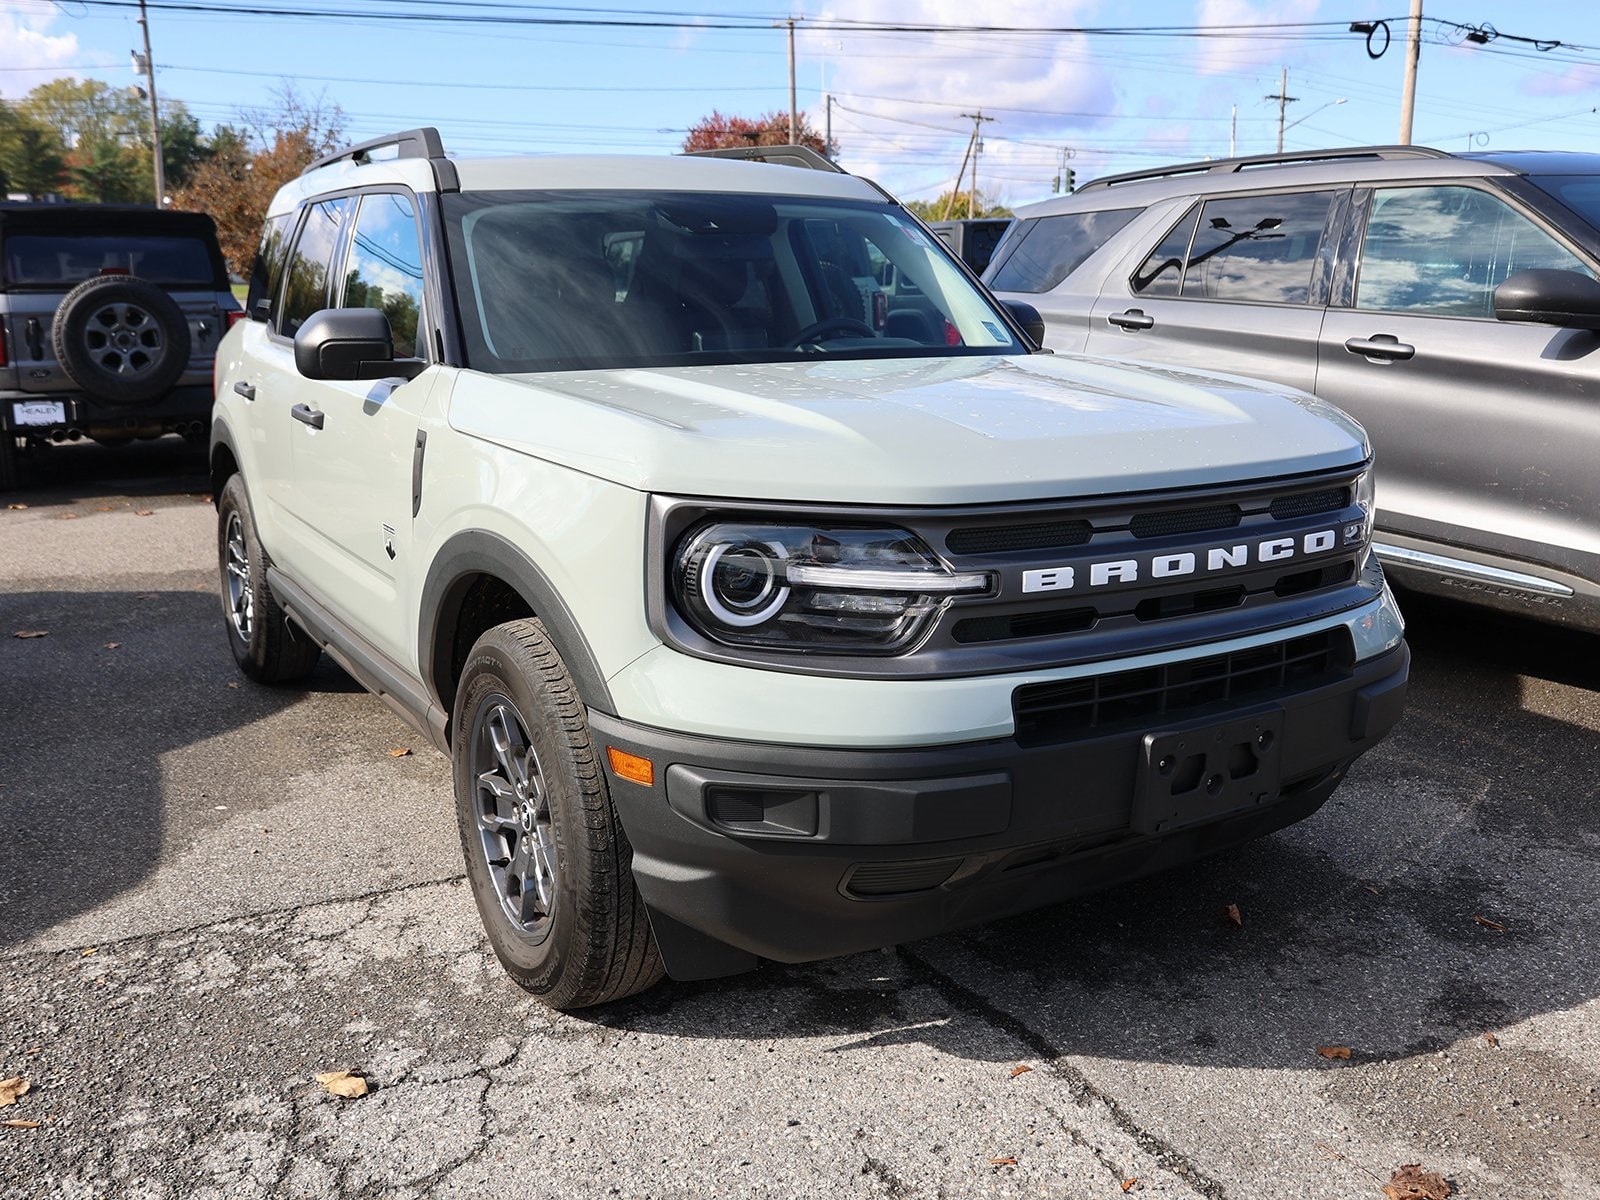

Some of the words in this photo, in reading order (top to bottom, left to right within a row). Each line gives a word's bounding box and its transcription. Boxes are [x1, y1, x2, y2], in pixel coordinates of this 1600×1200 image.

[21, 407, 58, 415] HEALEY
[1022, 529, 1336, 594] BRONCO
[1440, 577, 1563, 607] EXPLORER
